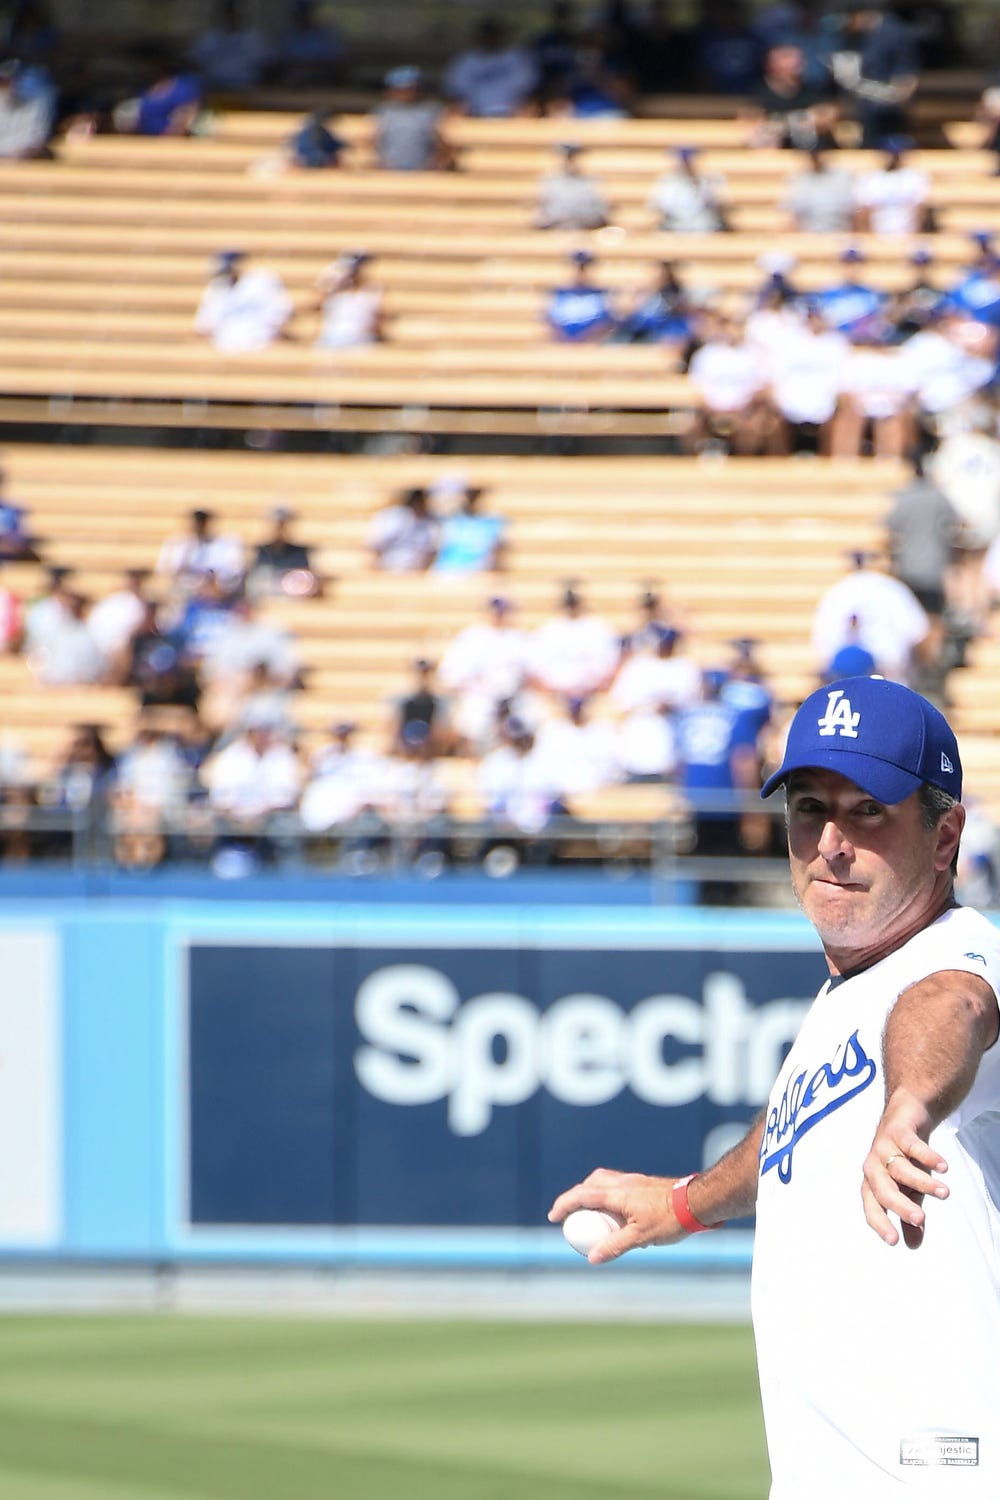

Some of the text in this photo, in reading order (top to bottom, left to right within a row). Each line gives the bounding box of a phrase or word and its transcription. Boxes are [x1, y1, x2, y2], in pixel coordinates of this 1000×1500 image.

[817, 690, 860, 738] LA
[352, 963, 816, 1137] Spectr
[760, 1029, 877, 1185] odgers
